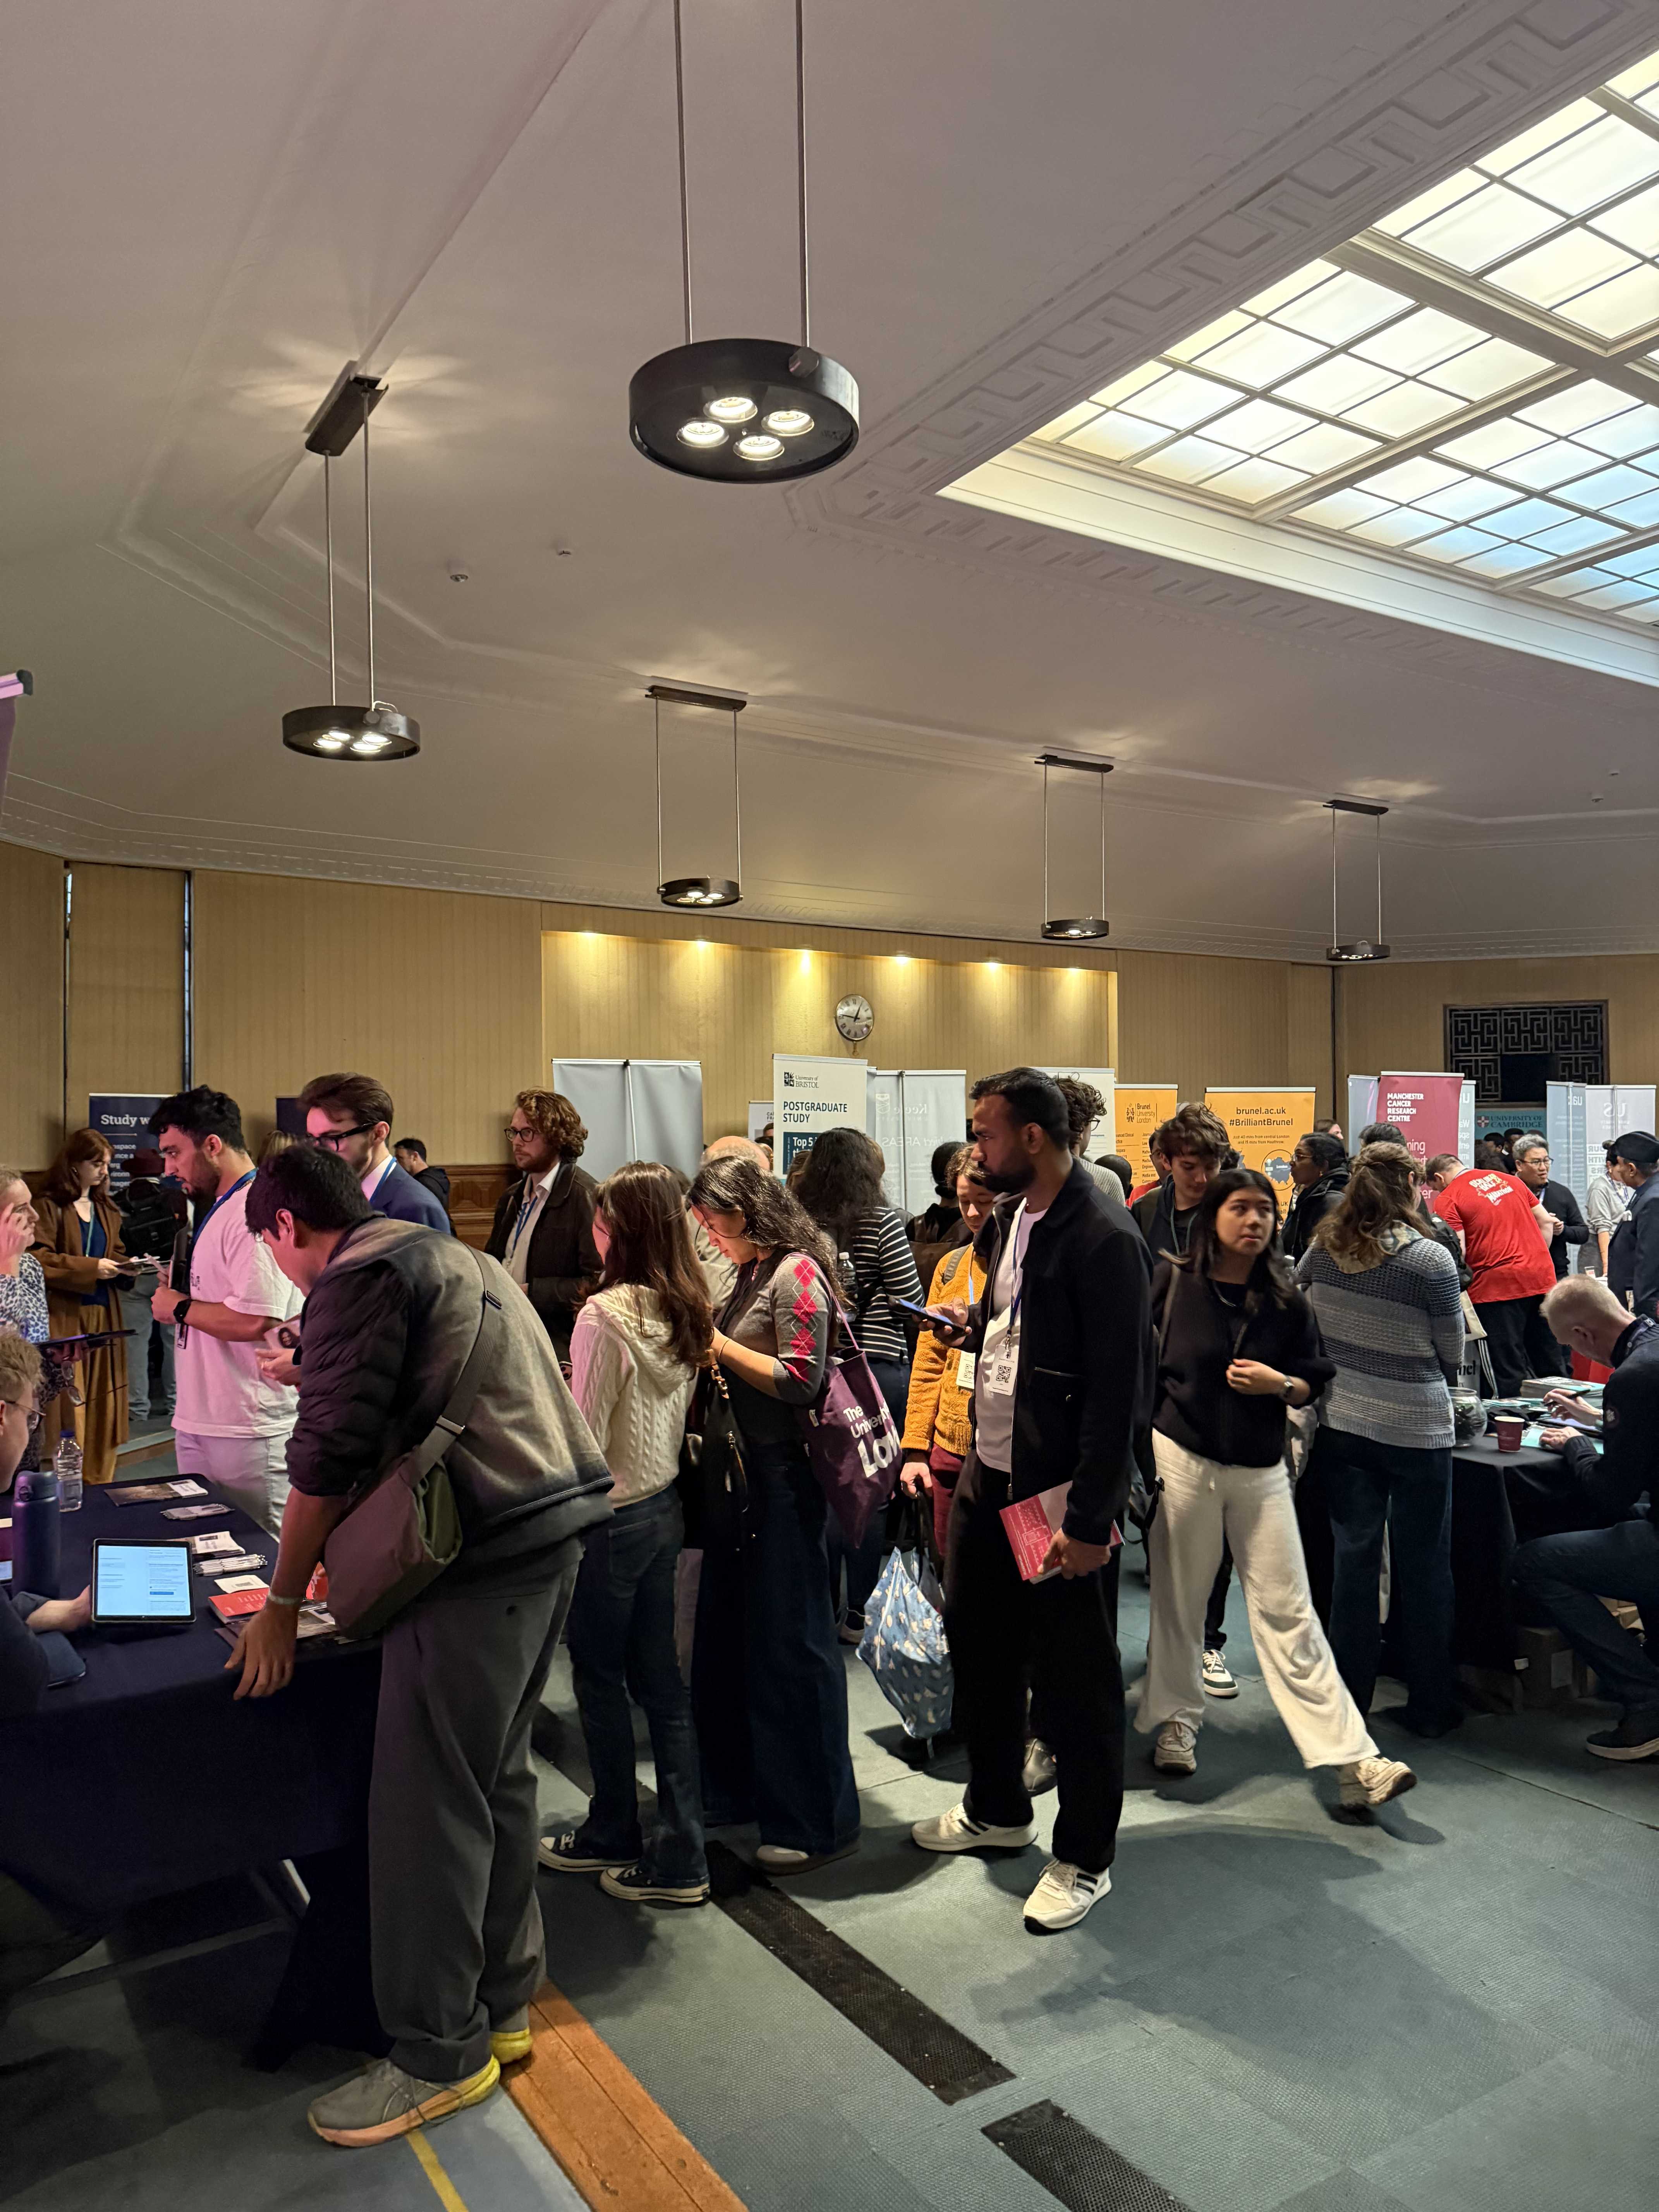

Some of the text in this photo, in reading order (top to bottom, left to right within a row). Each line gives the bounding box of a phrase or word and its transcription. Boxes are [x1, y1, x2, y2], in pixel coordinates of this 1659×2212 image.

[795, 1080, 819, 1089] BRISTOL
[783, 1101, 848, 1113] POSTGRADUATE
[1236, 1106, 1286, 1115] brunel.ac.uk
[101, 1114, 150, 1127] Study w
[783, 1113, 810, 1123] STUDY
[1229, 1118, 1293, 1127] #BrilliantBrunel
[792, 1137, 807, 1149] Top
[808, 1137, 813, 1147] 5
[1407, 1139, 1425, 1155] ning
[1421, 1189, 1433, 1199] er
[1486, 1185, 1514, 1204] MARATHON
[843, 1406, 864, 1422] The
